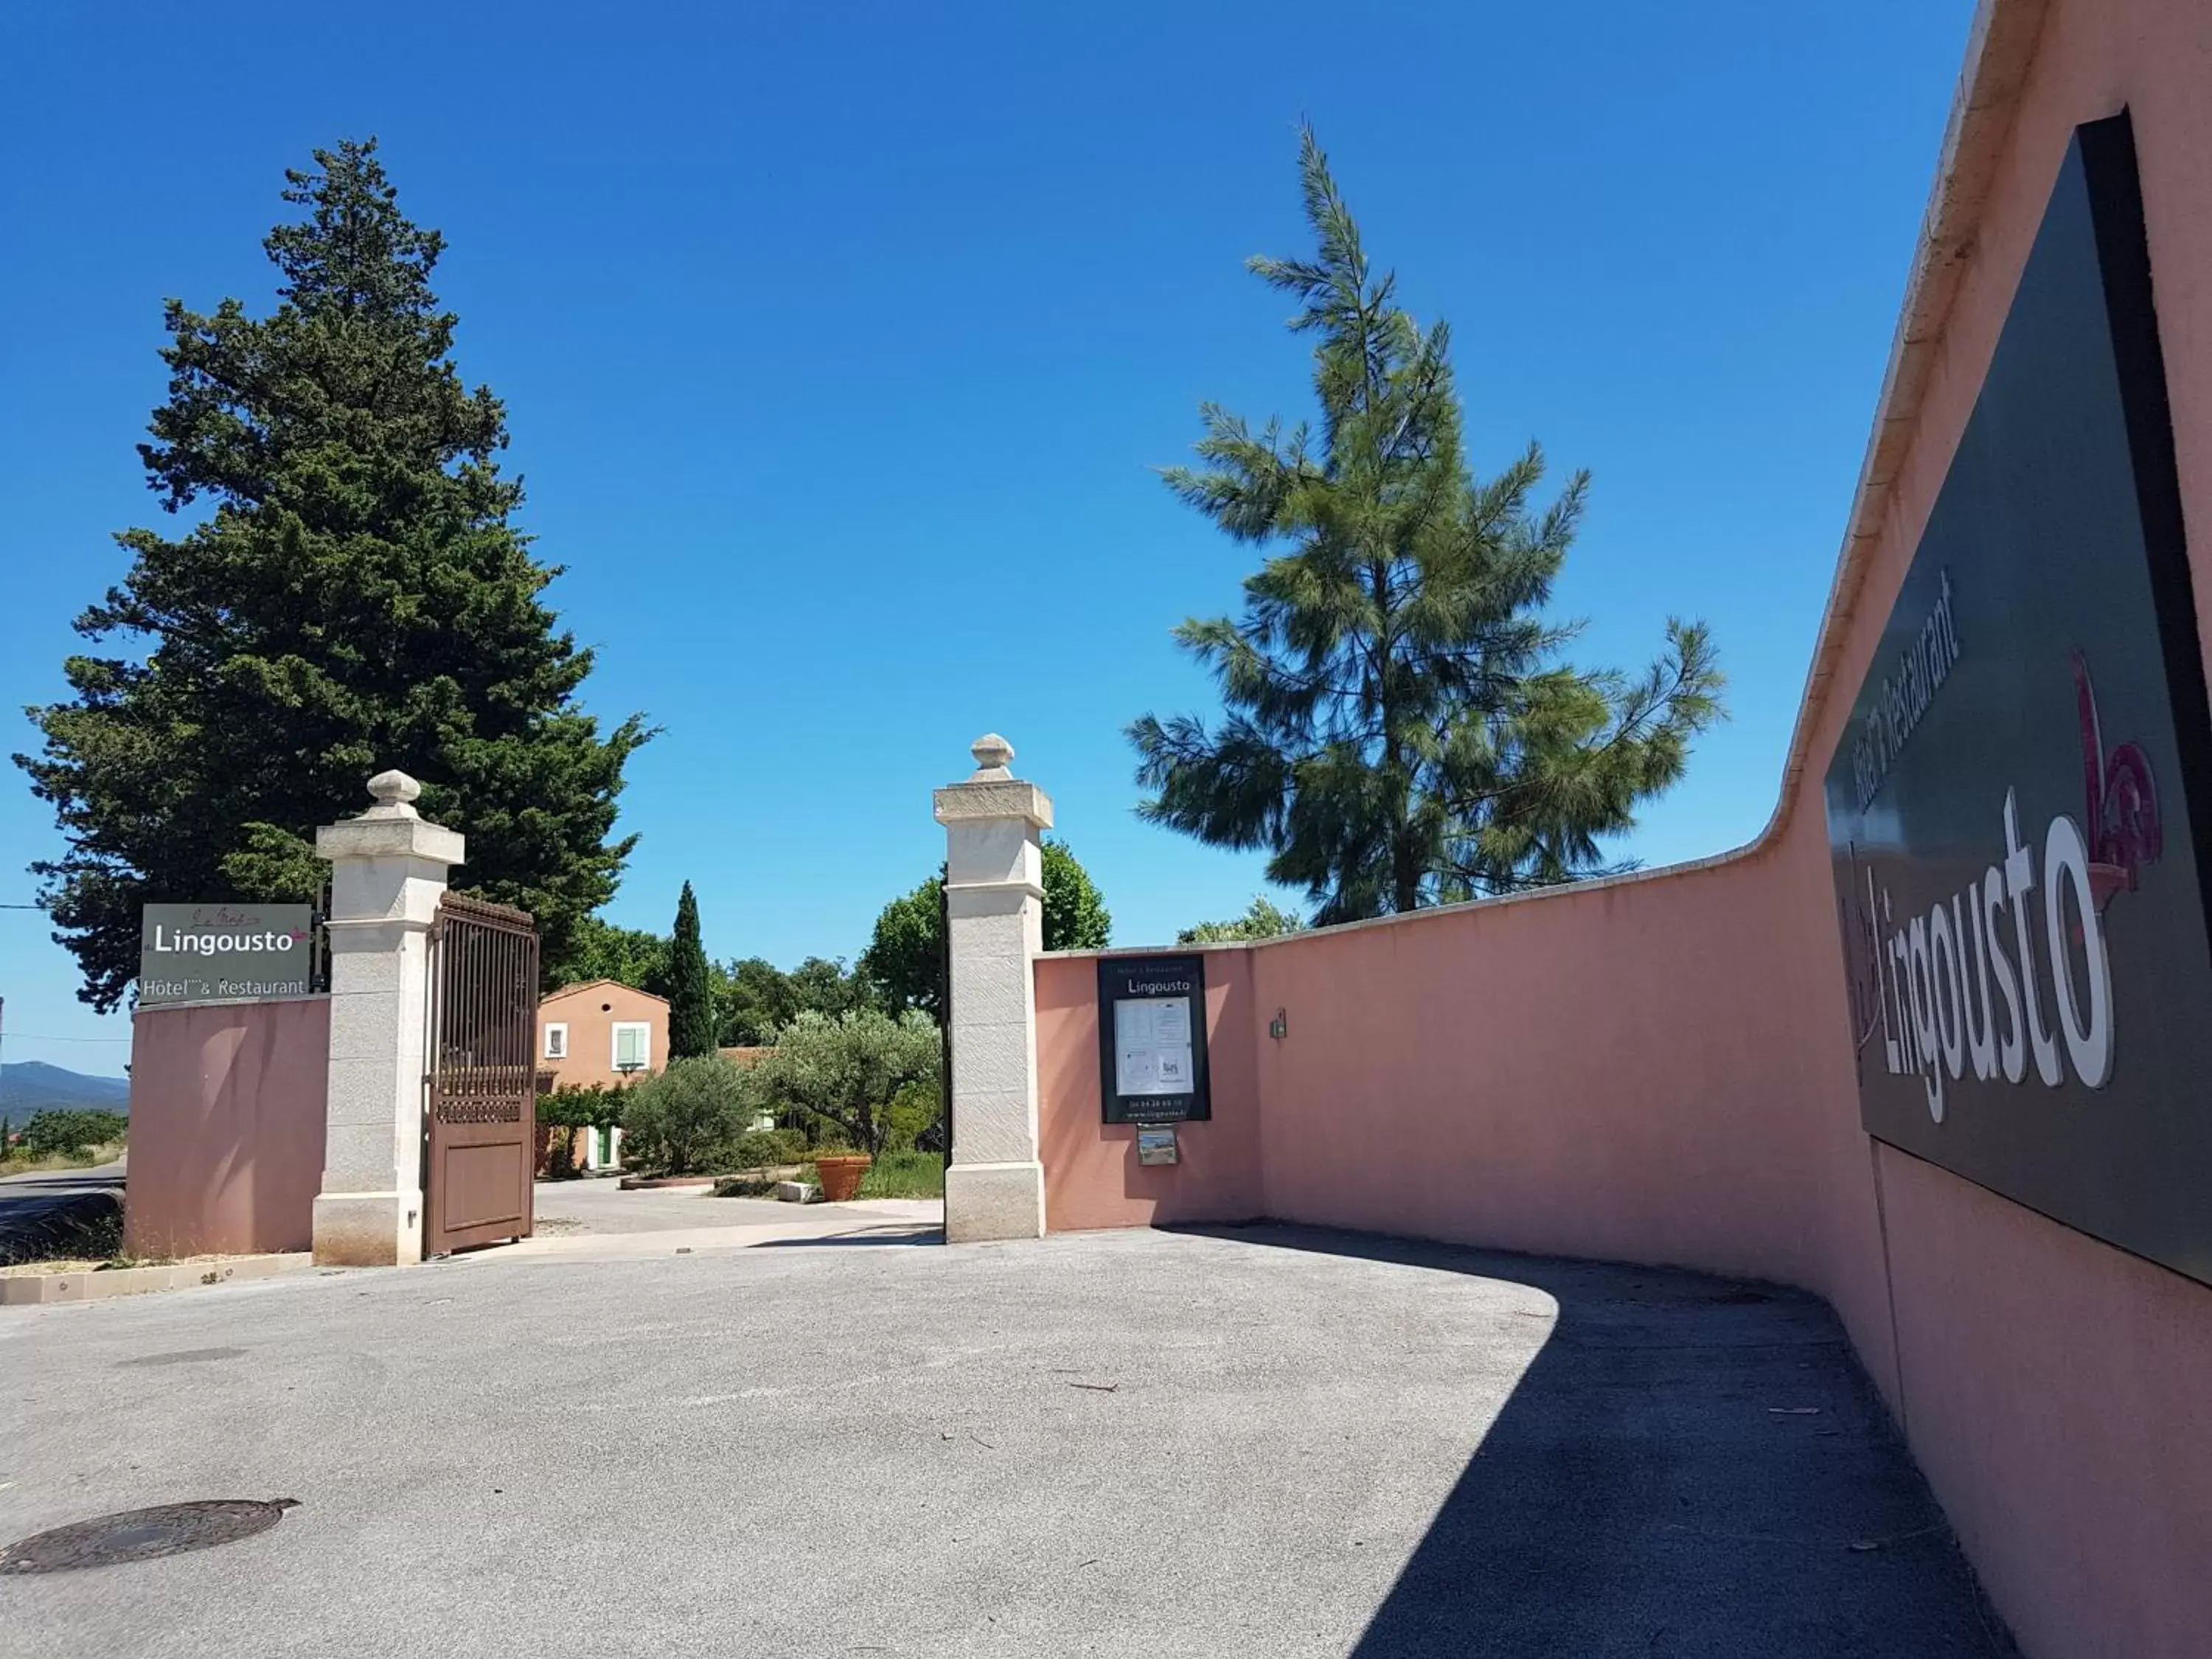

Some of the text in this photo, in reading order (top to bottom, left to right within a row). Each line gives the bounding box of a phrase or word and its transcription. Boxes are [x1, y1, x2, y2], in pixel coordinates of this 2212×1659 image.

[1883, 568, 1960, 761] Restaurant
[155, 924, 293, 956] Lingousto
[1868, 784, 2113, 1124] Lingousto
[143, 978, 305, 995] Hôtel & Restaurant
[1128, 978, 1191, 995] Lingousto
